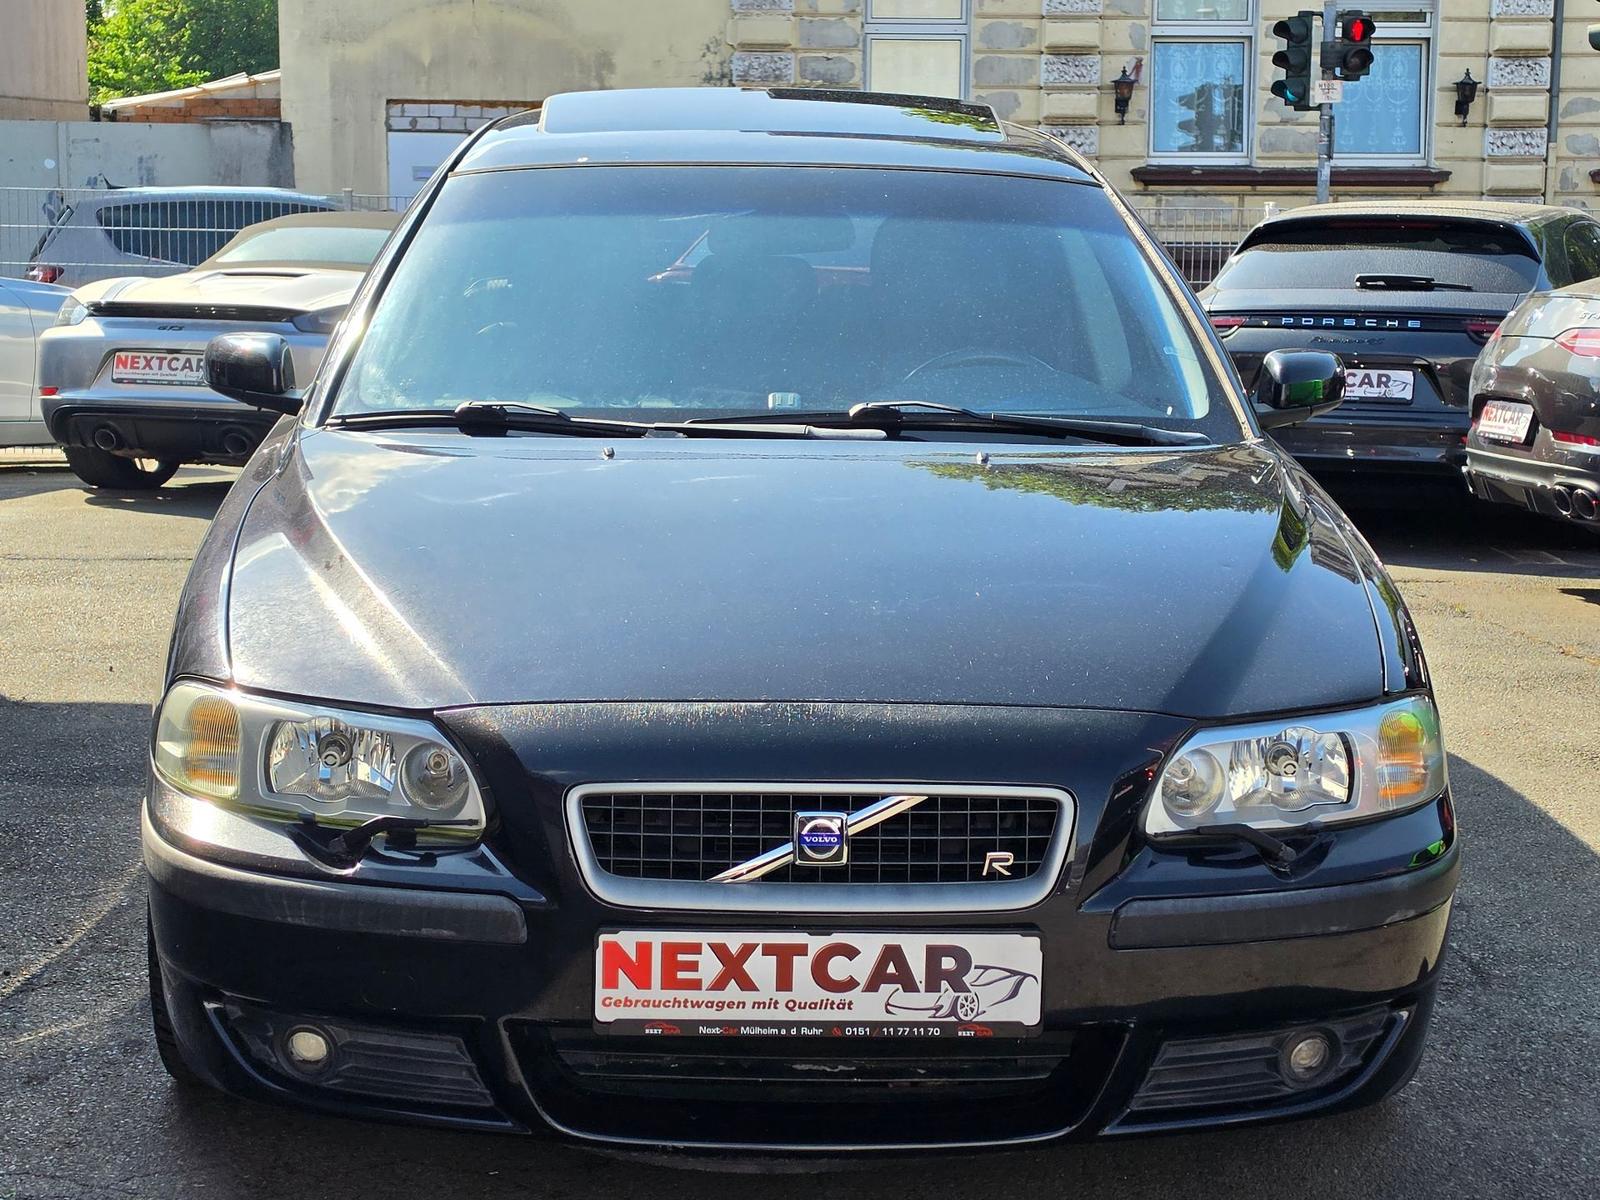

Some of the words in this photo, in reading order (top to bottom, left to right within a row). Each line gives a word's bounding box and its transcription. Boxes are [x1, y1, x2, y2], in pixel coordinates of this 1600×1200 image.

[1281, 317, 1421, 328] PORSCHE
[982, 851, 1014, 876] R
[601, 940, 973, 994] NEXTCAR
[601, 996, 747, 1012] Gebrauchtwagen
[751, 997, 780, 1010] mit
[784, 997, 854, 1012] Qualität
[740, 1025, 779, 1035] Mülheim
[801, 1026, 824, 1035] Ruhr
[845, 1027, 870, 1036] 0151
[882, 1027, 894, 1036] 11
[897, 1027, 909, 1036] 77
[912, 1027, 924, 1036] 11
[928, 1027, 941, 1036] 70
